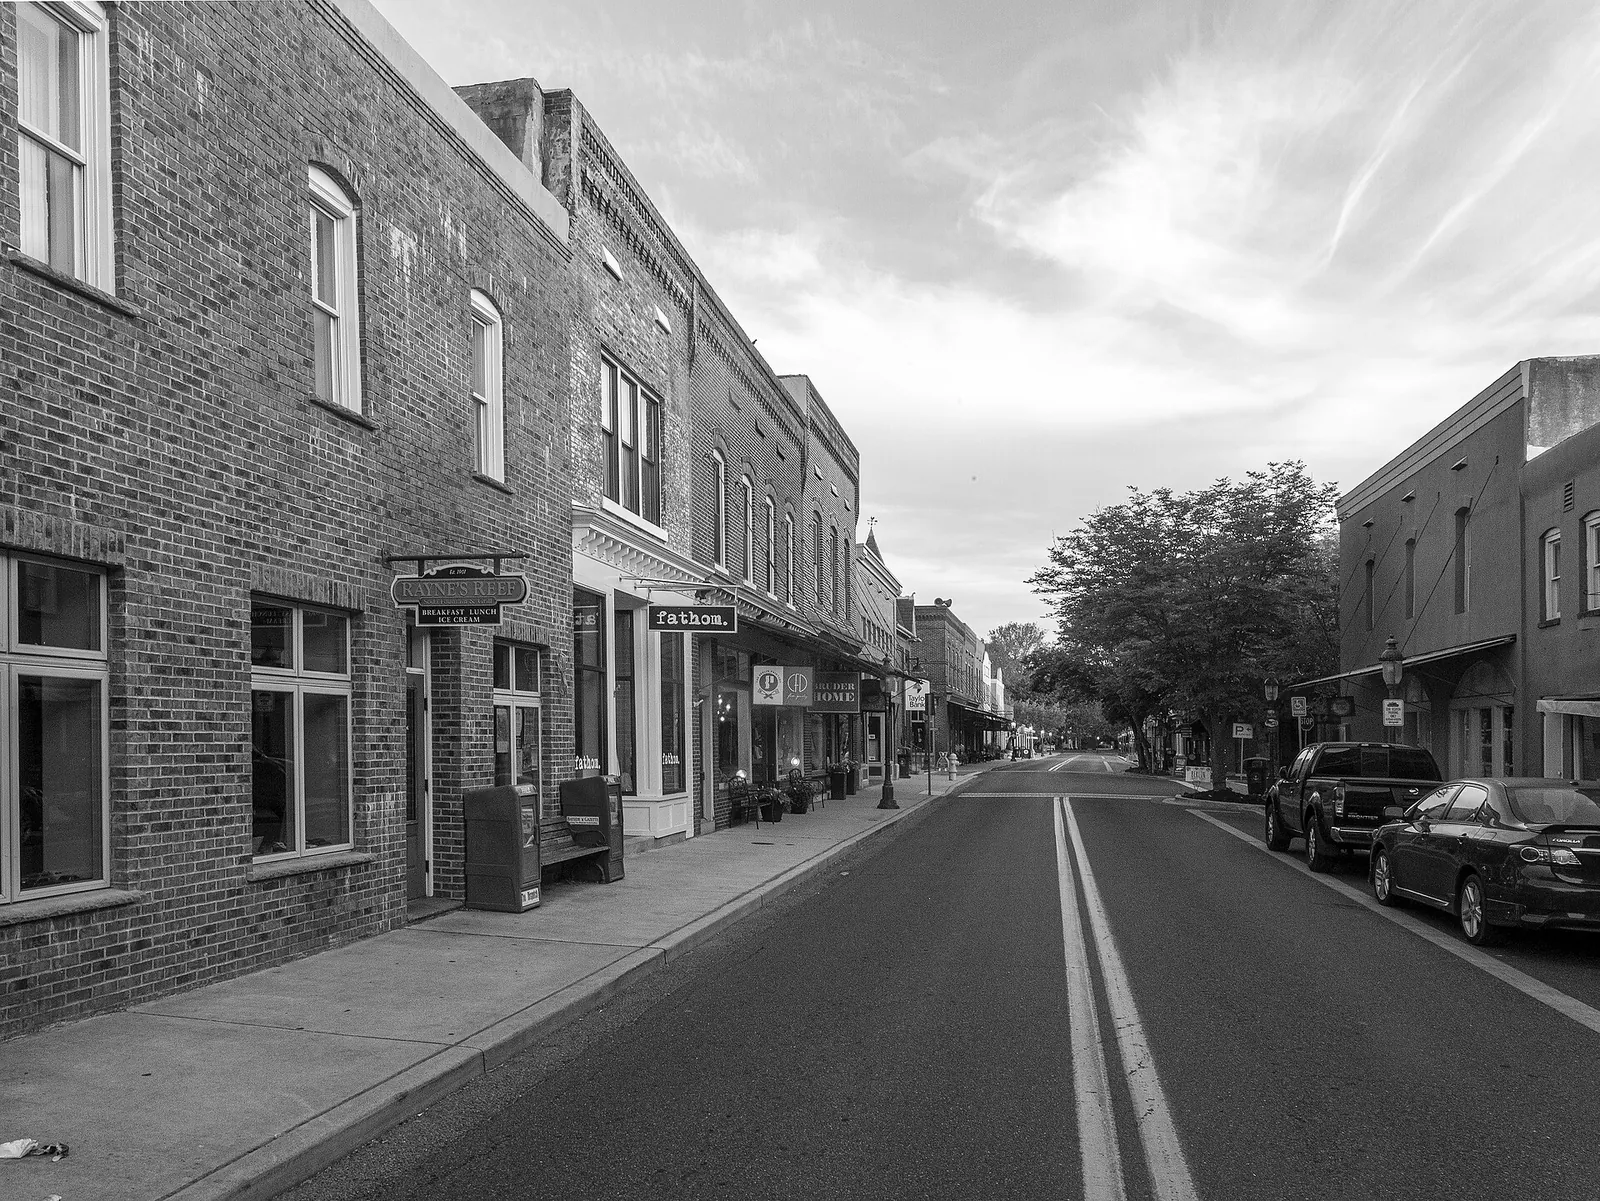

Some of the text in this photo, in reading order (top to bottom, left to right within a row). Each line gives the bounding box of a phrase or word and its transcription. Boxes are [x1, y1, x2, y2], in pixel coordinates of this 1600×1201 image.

[402, 581, 517, 596] RAYNE'S REEF
[422, 608, 465, 616] BREAKFAST
[656, 611, 728, 627] fathom.
[813, 691, 855, 702] HOME
[908, 694, 926, 703] Taylo
[1300, 717, 1314, 725] STOP
